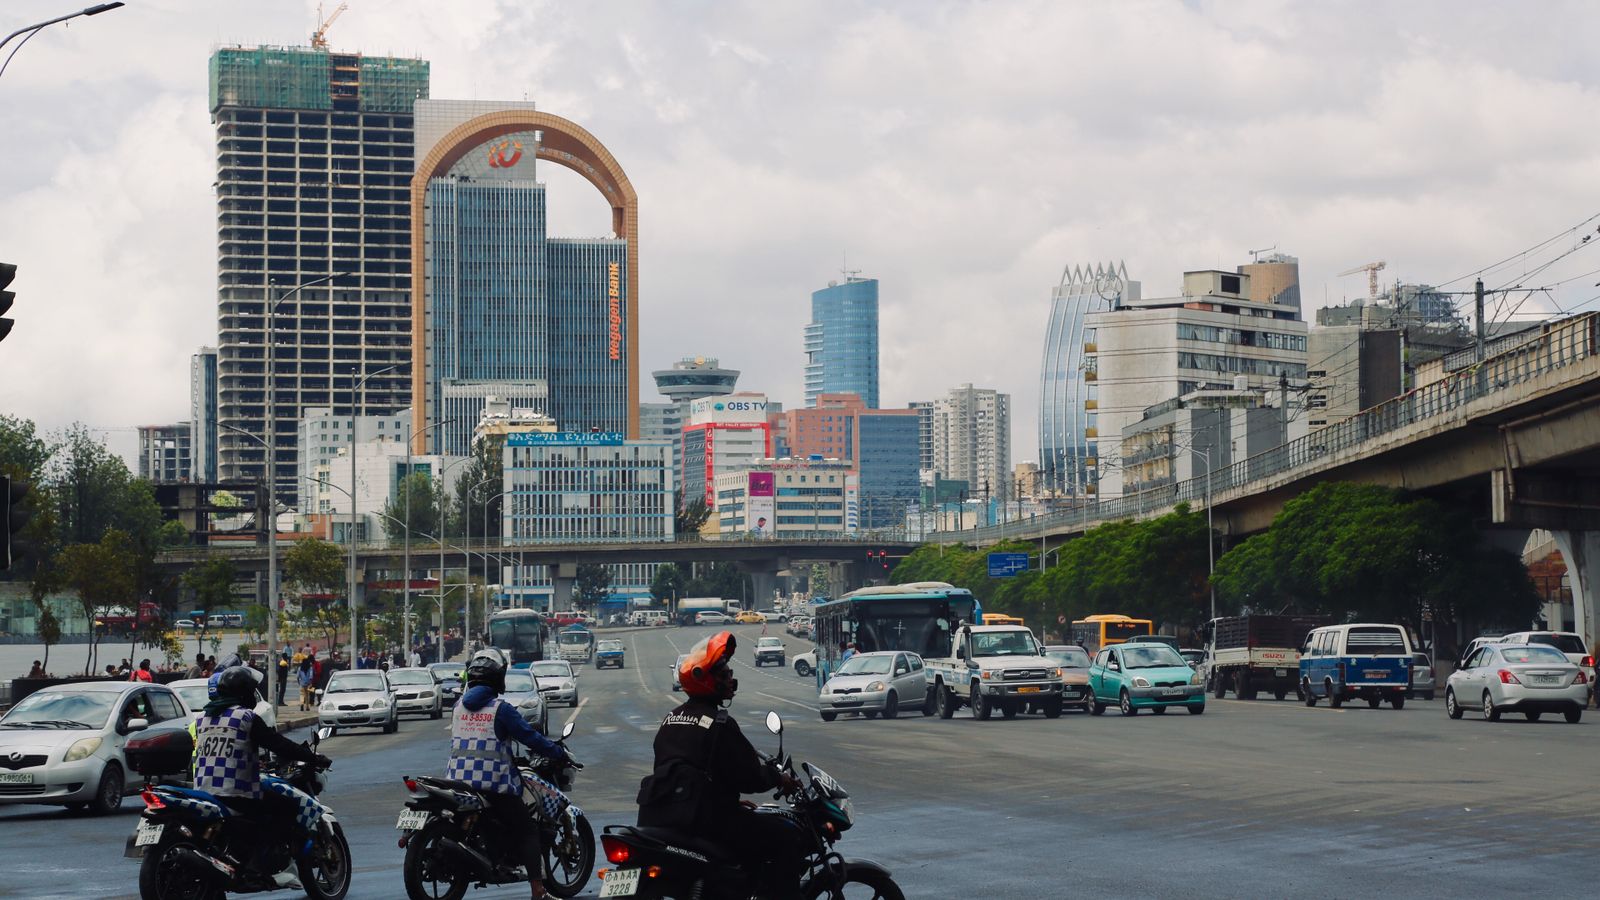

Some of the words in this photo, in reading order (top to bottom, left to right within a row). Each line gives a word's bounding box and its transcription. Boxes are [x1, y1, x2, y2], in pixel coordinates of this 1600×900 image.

[609, 262, 619, 296] Bank
[727, 402, 750, 411] OBS
[753, 402, 767, 411] TV
[469, 713, 492, 722] 3-8530
[662, 710, 699, 726] Radisson
[203, 736, 235, 758] 6275
[607, 882, 631, 896] 3228
